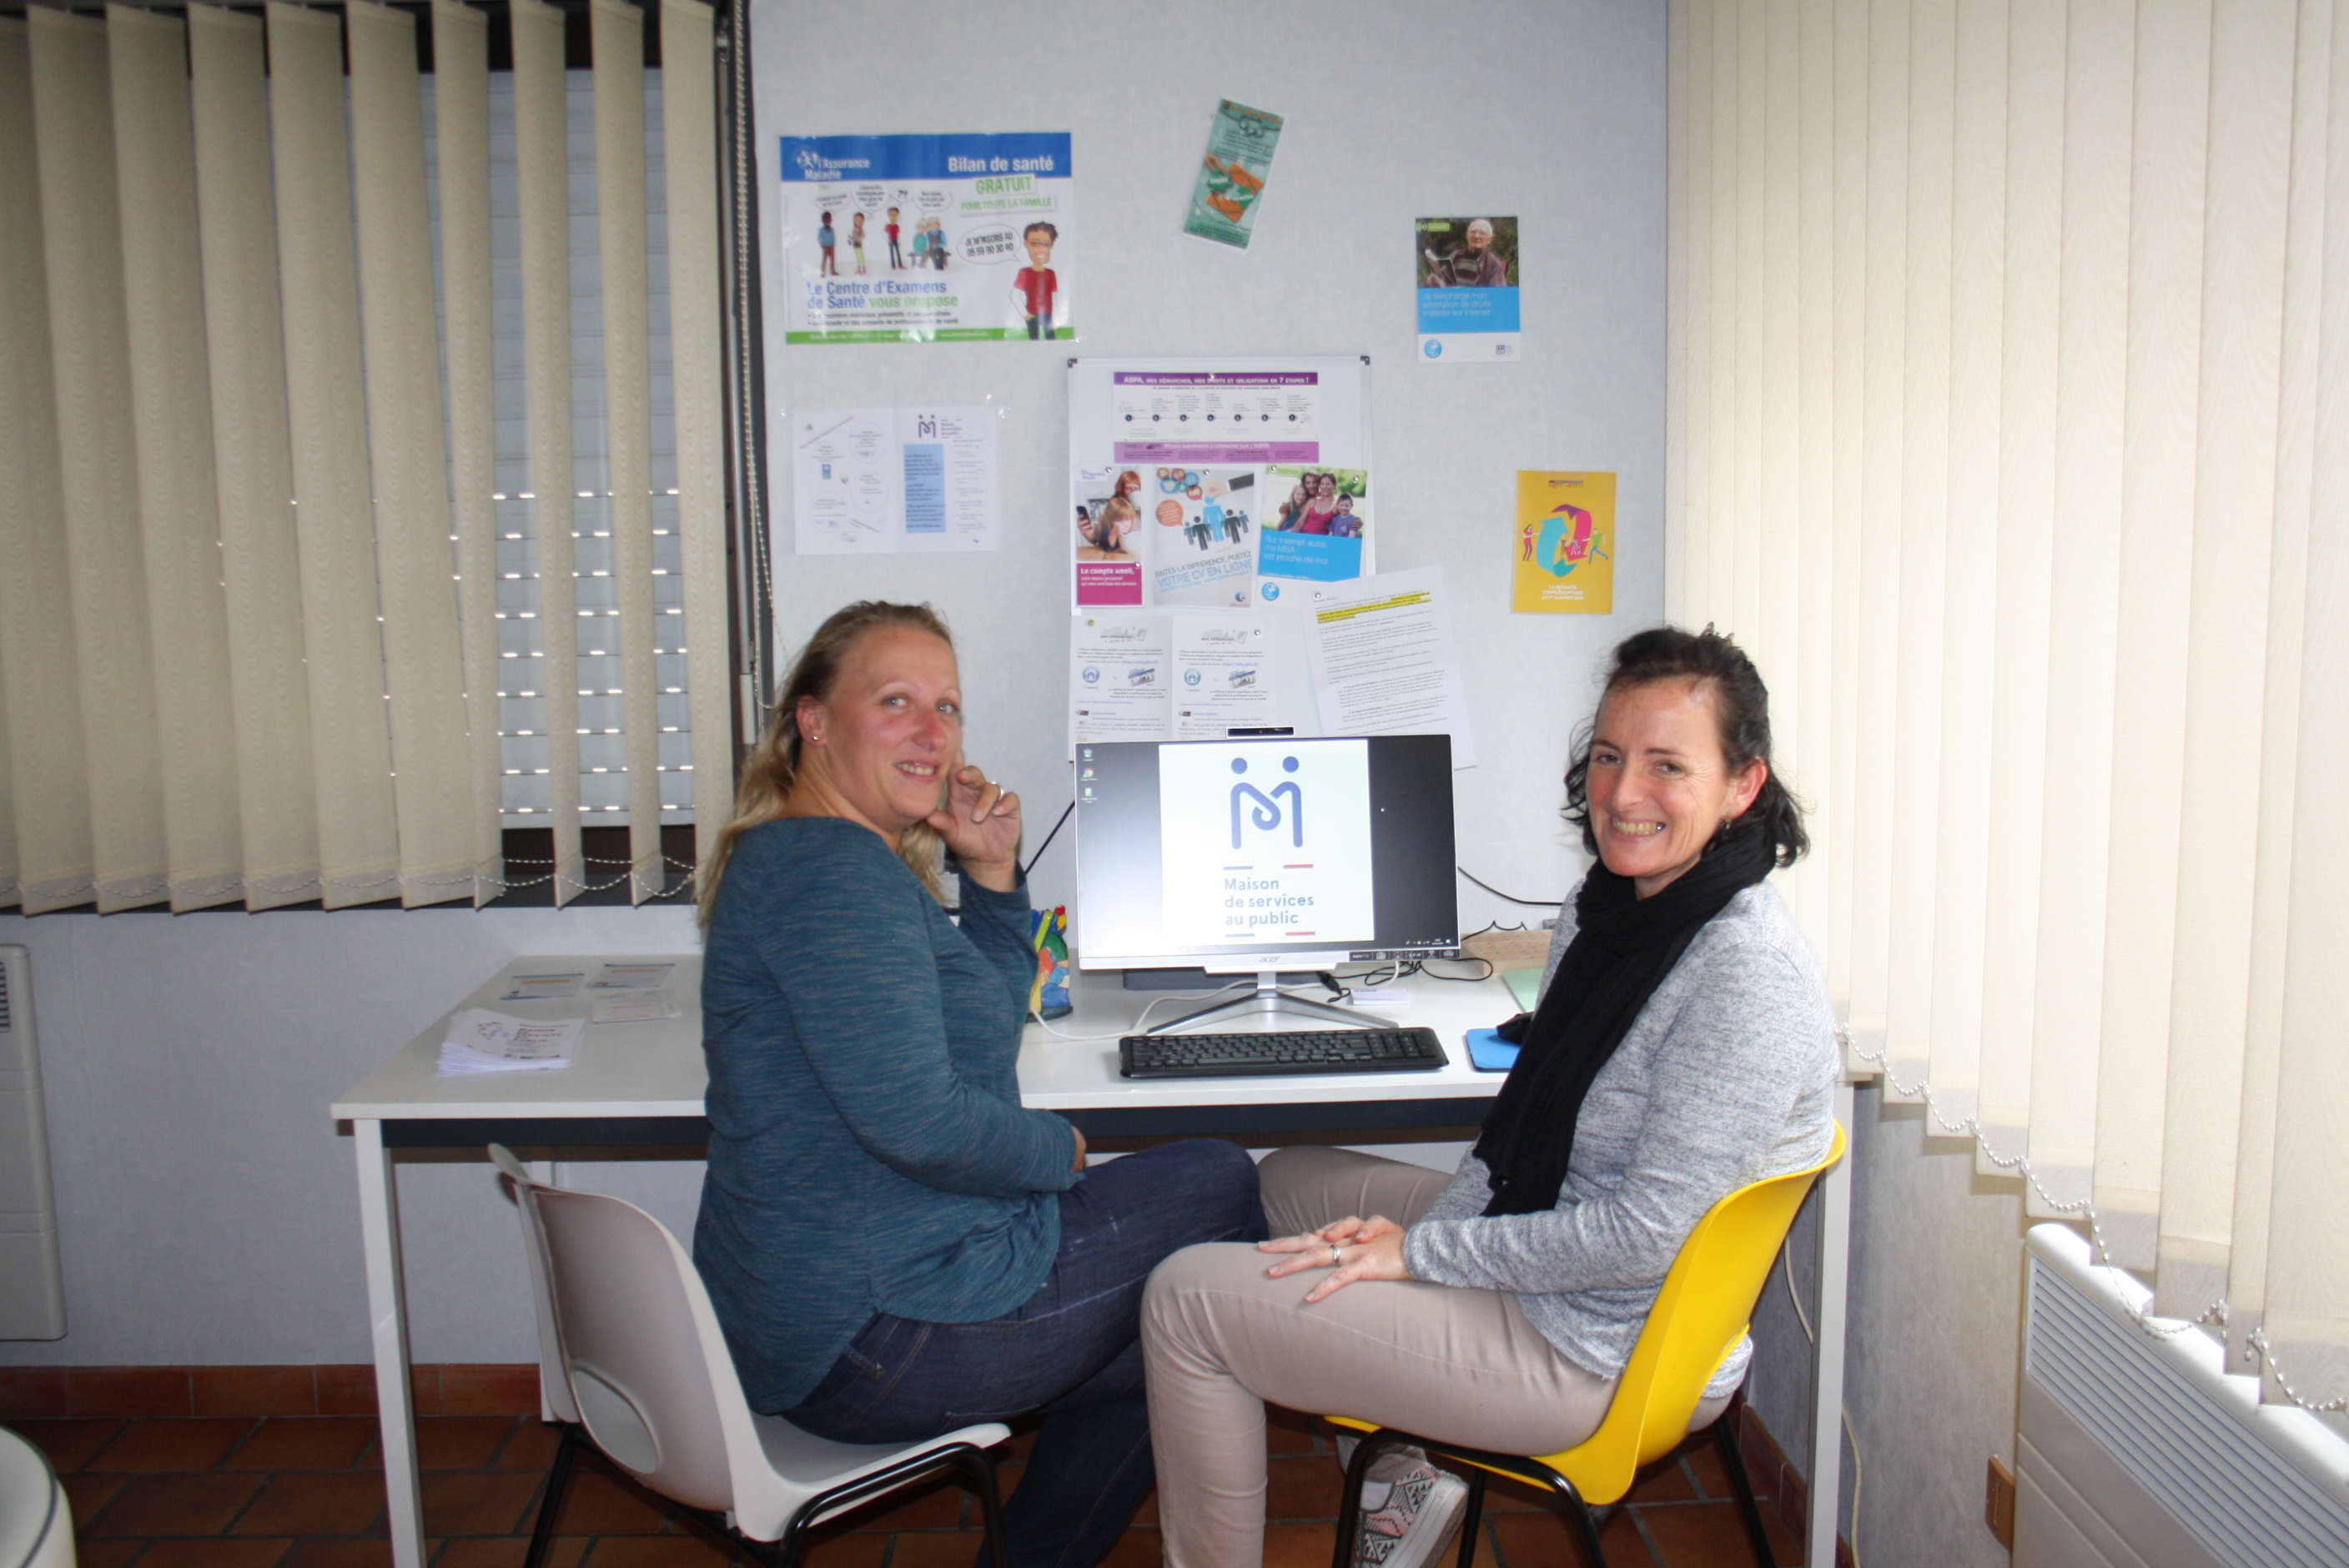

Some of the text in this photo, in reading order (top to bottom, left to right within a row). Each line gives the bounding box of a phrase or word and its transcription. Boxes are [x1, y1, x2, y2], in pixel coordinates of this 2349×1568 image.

[948, 155, 1054, 172] Bilan de santé
[805, 169, 842, 180] Maladie
[976, 176, 1032, 194] GRATUIT
[960, 197, 1052, 210] POUR TOUTE LA FAMILLE
[1004, 232, 1013, 240] AU
[967, 248, 975, 257] 05
[976, 247, 984, 256] 59
[807, 280, 946, 295] Le Centre d'Examens
[807, 296, 822, 309] de
[827, 295, 865, 309] Santé
[869, 297, 900, 308] vous
[1114, 567, 1134, 575] ameli,
[1155, 566, 1176, 578] FAITES
[1177, 565, 1186, 573] LA
[1227, 550, 1251, 561] POSTEZ
[1156, 571, 1190, 589] VOTRE
[1191, 568, 1205, 580] CV
[1207, 565, 1221, 577] EN
[1223, 558, 1253, 574] LIGNE
[1225, 877, 1279, 891] Maison
[1225, 893, 1314, 907] de services
[1225, 911, 1298, 928] au public
